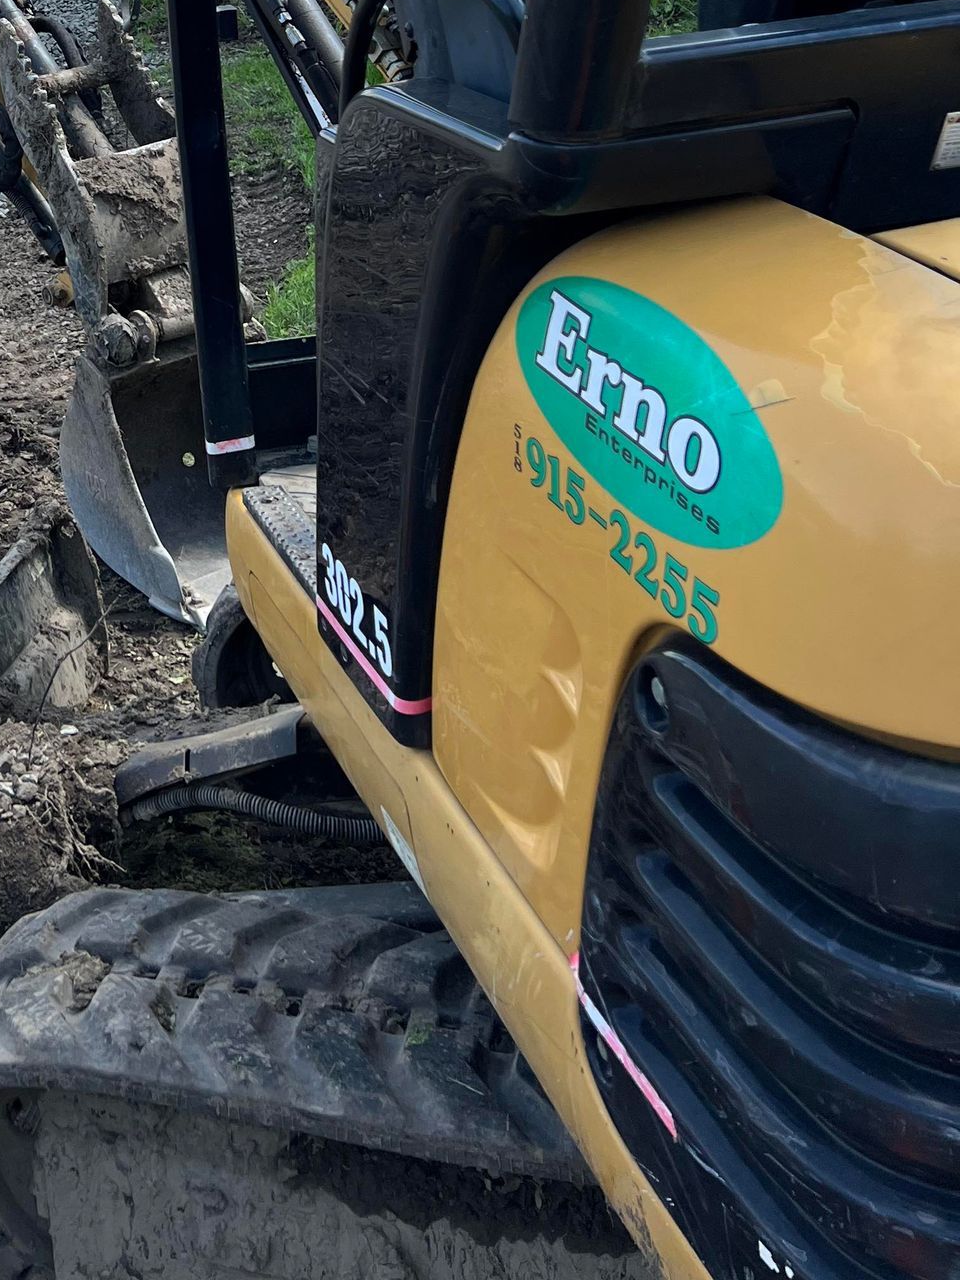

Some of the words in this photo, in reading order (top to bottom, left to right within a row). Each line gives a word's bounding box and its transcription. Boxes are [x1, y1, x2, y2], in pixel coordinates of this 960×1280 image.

[536, 288, 722, 494] Erno
[585, 413, 720, 535] Enterprises
[322, 542, 392, 677] 302.5
[526, 437, 720, 644] 915-2255
